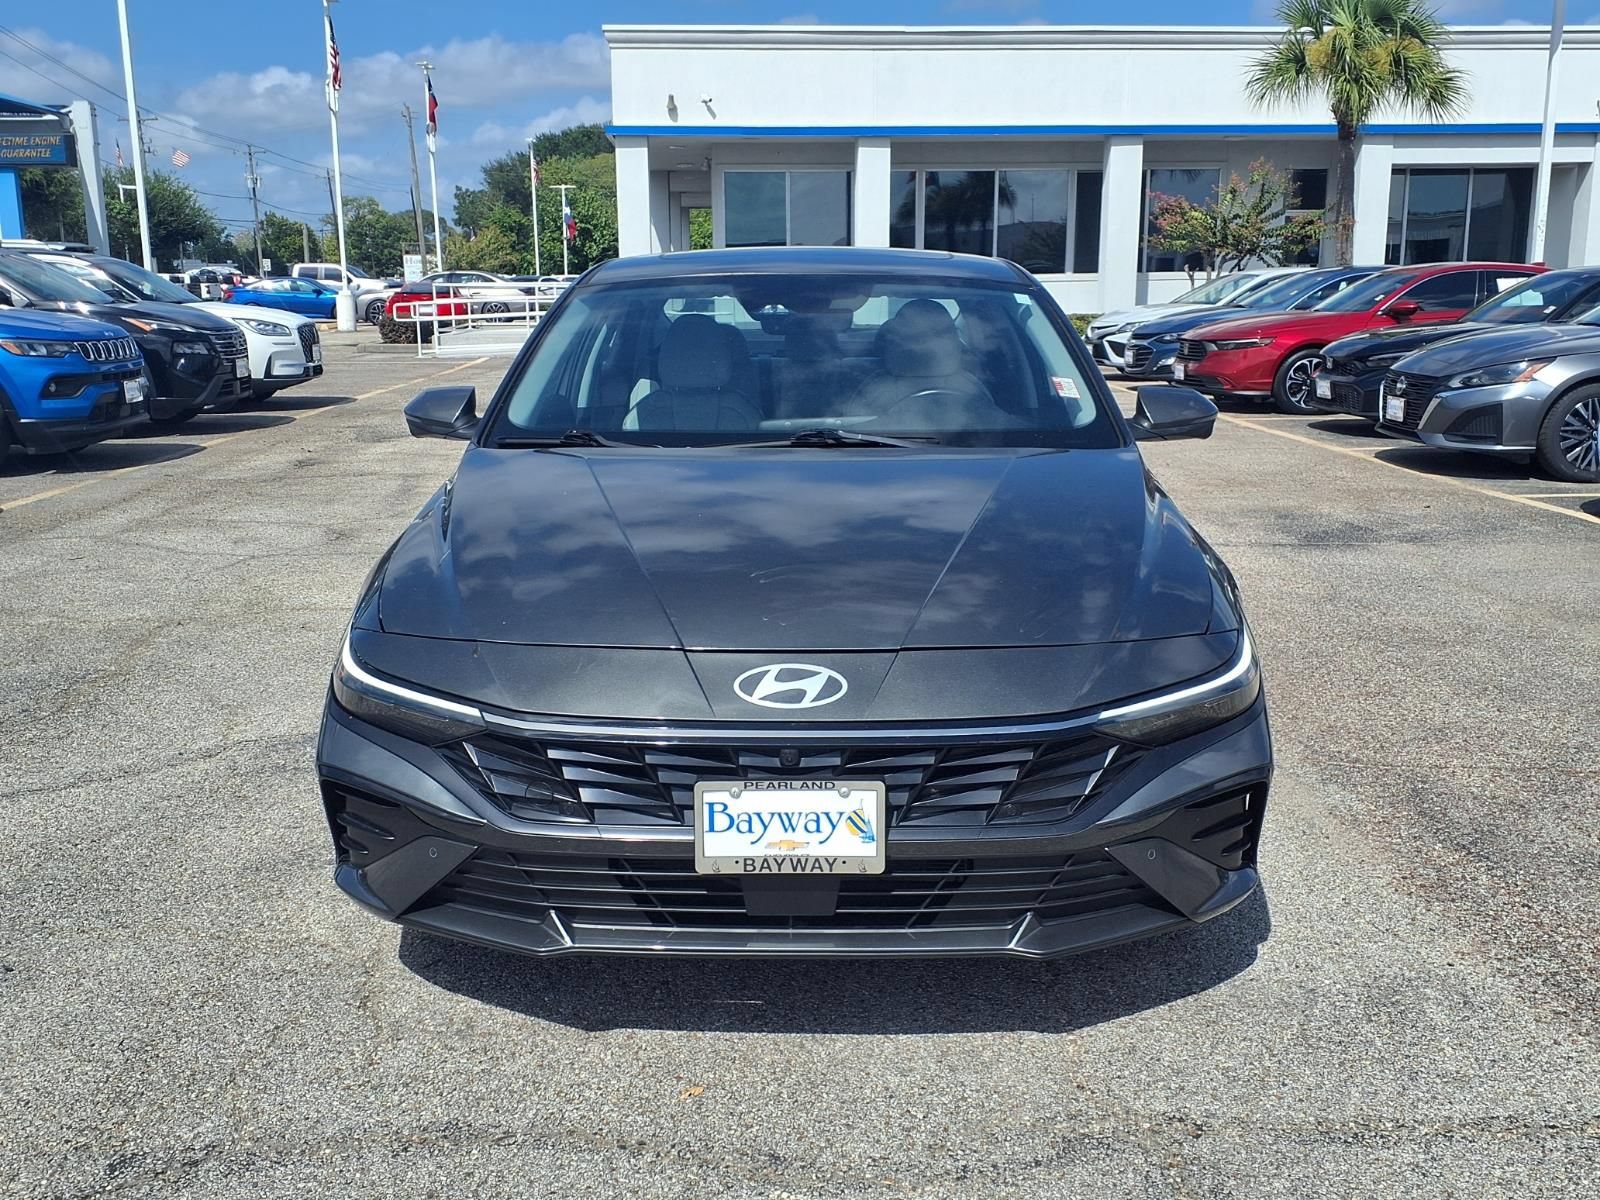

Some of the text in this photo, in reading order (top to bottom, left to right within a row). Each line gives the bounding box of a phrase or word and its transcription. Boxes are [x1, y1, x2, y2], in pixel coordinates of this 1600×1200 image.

[30, 136, 61, 145] ENGINE
[0, 148, 52, 158] GUARANTEE
[743, 781, 836, 790] PEARLAND
[704, 802, 846, 845] Bayway
[743, 857, 838, 873] BAYWAY
